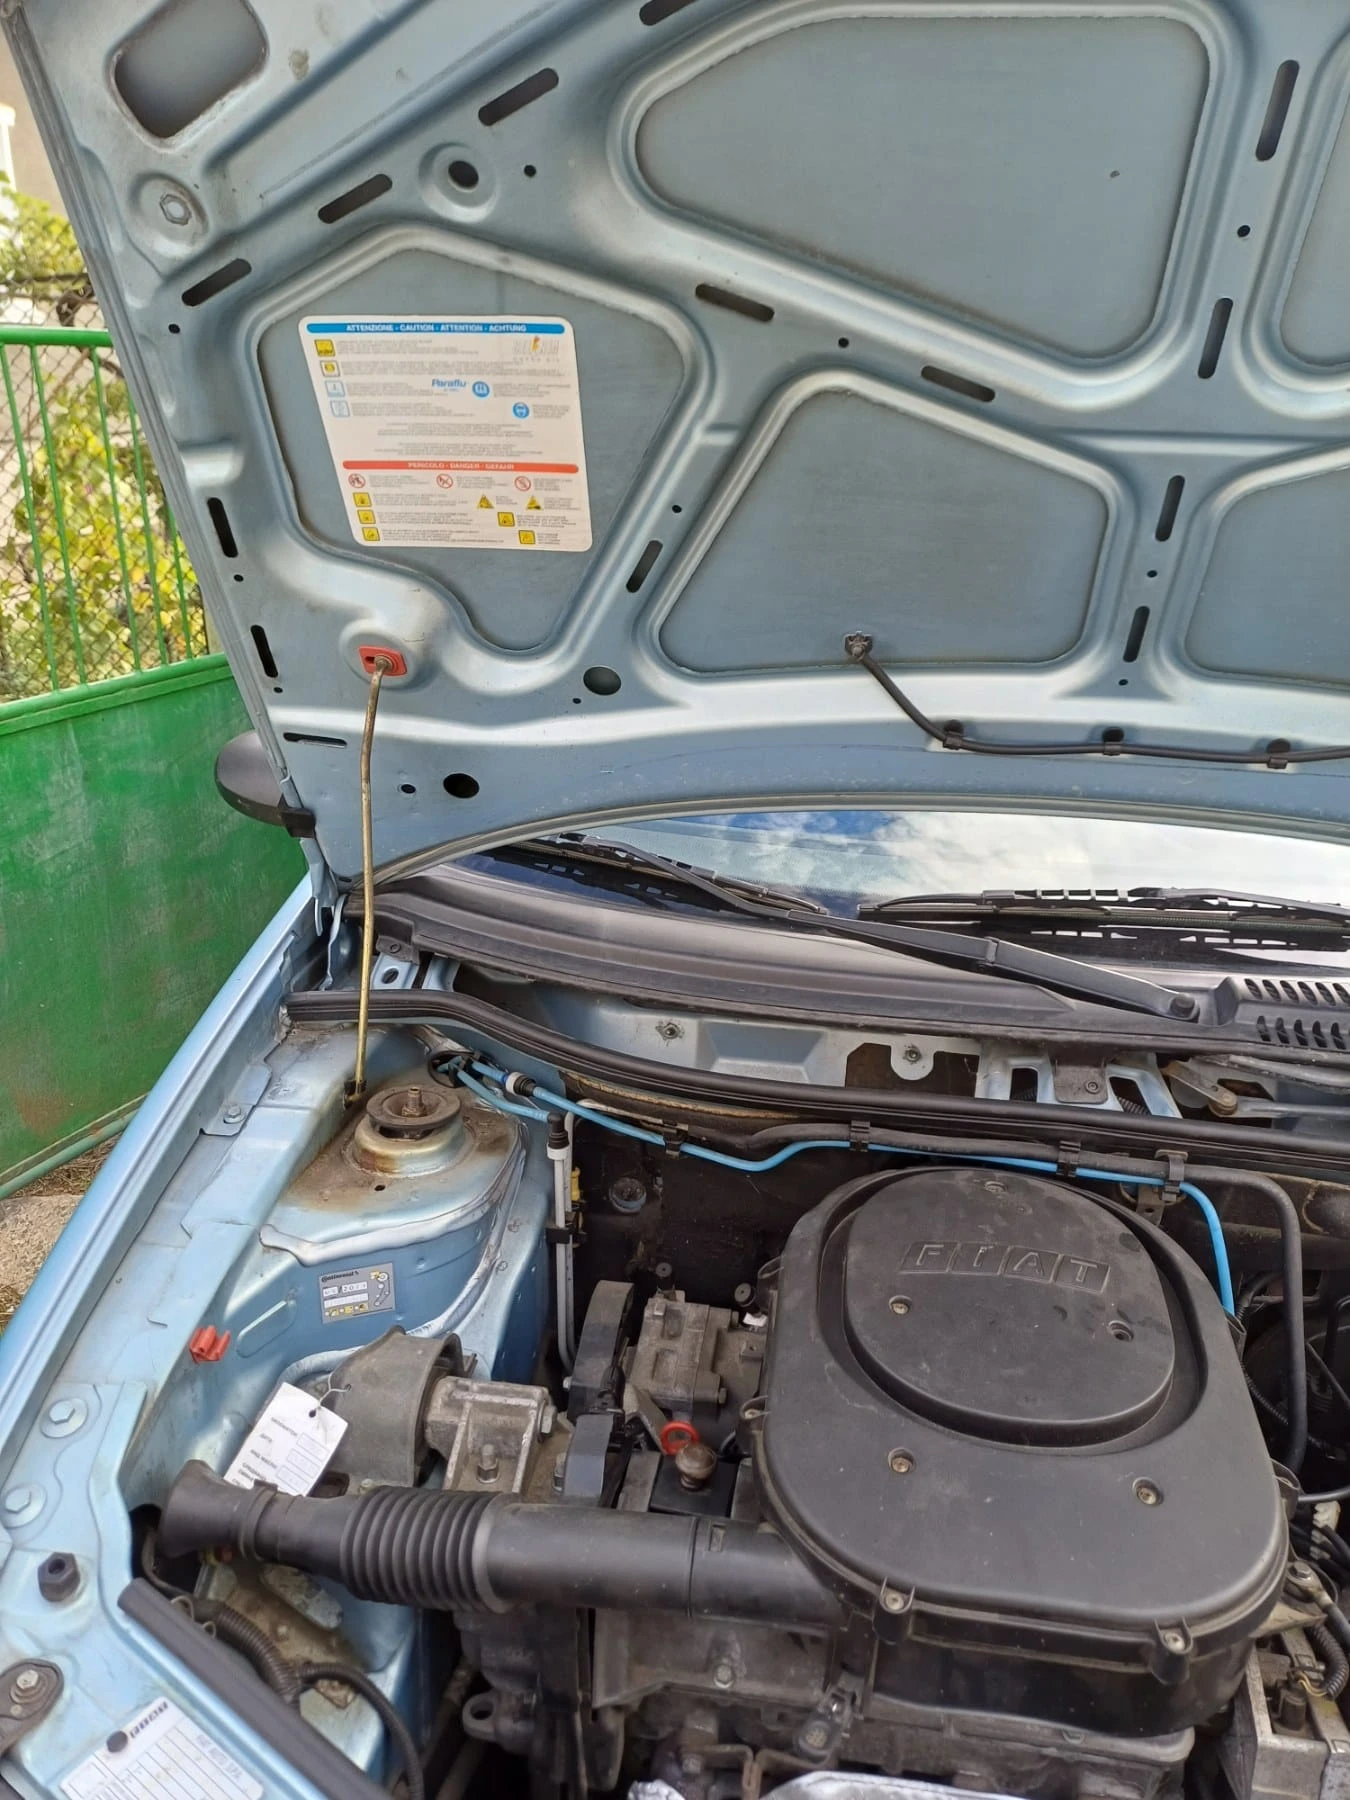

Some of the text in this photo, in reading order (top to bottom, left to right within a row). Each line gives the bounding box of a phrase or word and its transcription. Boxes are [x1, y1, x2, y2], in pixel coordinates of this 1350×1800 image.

[346, 324, 526, 332] ATTENZIONE CAUTION ATTENTION ACHTUNG
[914, 1242, 1100, 1284] FIAT
